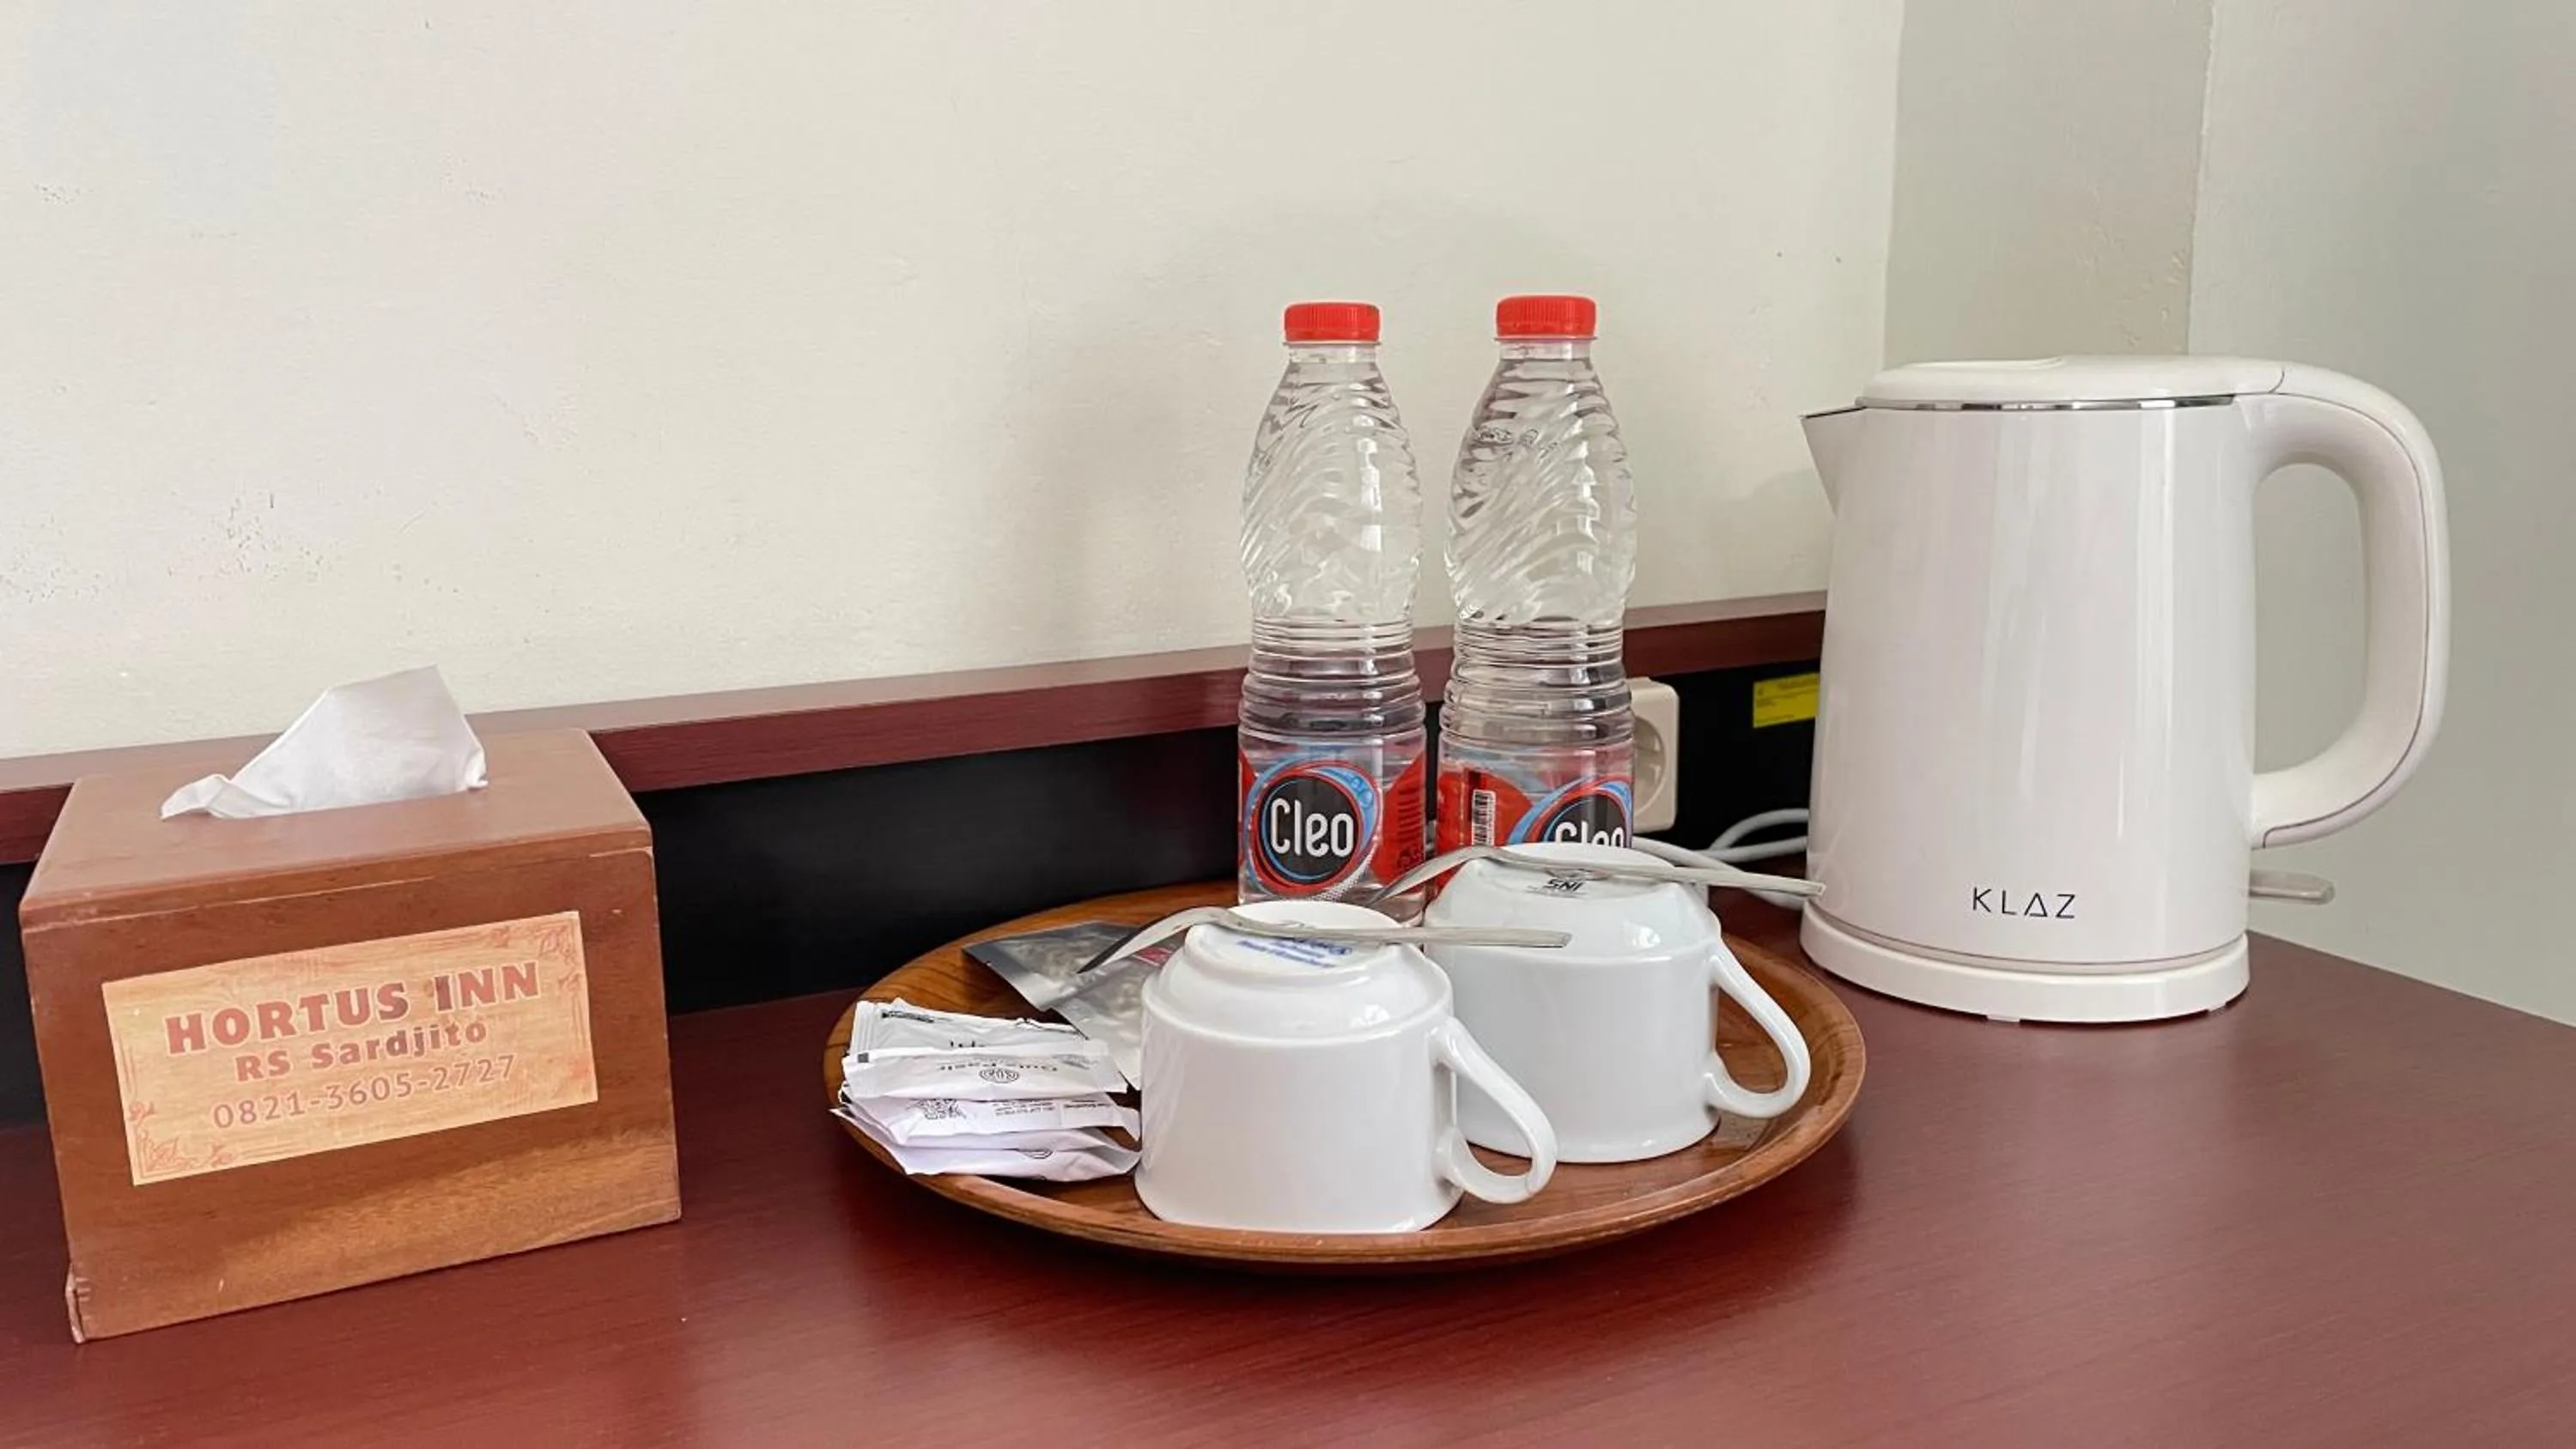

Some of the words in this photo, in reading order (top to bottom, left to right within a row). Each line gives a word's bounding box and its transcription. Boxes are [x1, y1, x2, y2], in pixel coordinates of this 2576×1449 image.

[1271, 797, 1354, 858] Cleo
[1972, 887, 2075, 919] KLAZ
[164, 982, 410, 1055] HORTUS
[434, 961, 539, 1012] INN
[234, 1049, 292, 1082] RS
[311, 1021, 488, 1070] Sardjito
[213, 1053, 515, 1129] 0821-3605-2727
